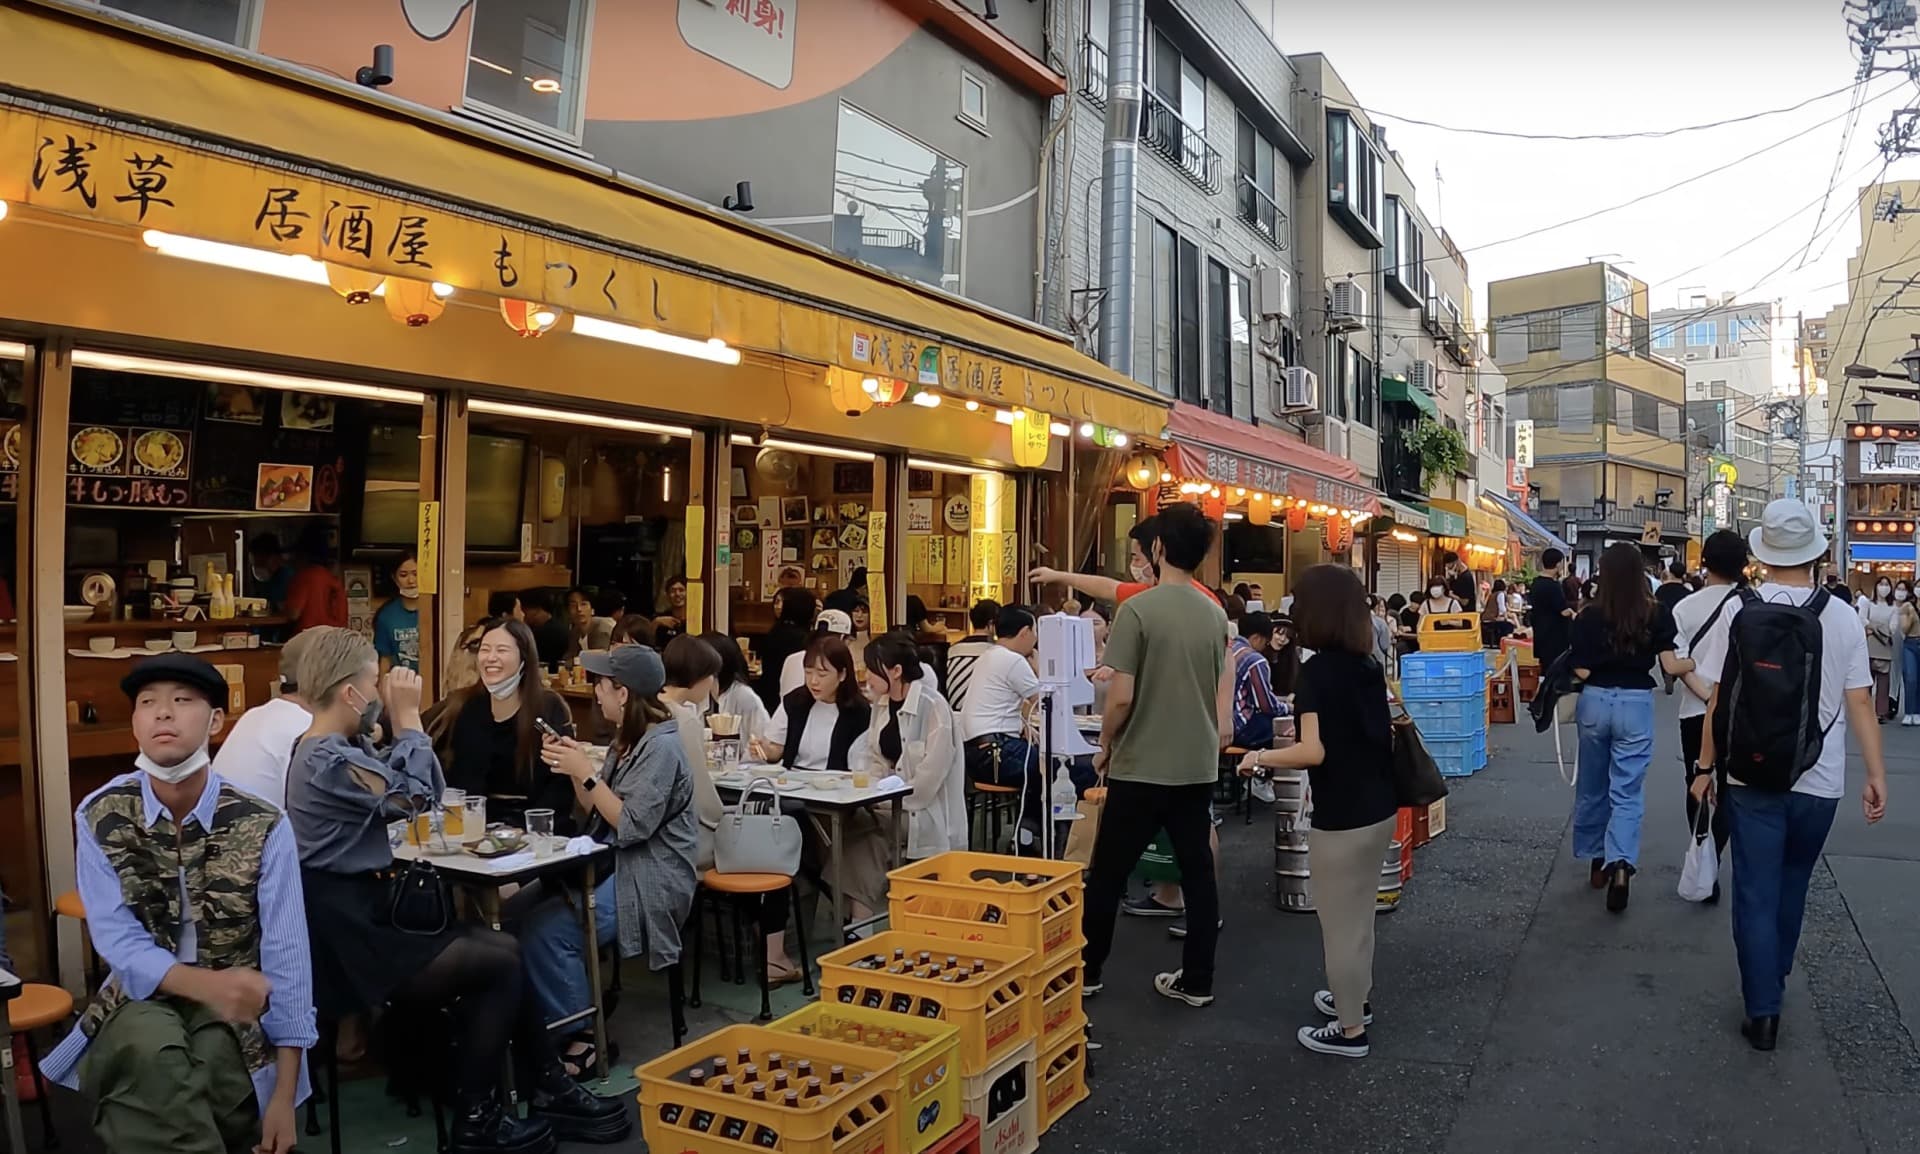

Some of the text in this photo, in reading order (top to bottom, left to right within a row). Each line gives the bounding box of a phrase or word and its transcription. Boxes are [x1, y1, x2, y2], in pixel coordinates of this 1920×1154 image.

[33, 134, 175, 222] 浅草
[254, 187, 433, 268] 居酒屋
[946, 354, 1005, 397] 居酒屋
[766, 535, 779, 580] ホッピー
